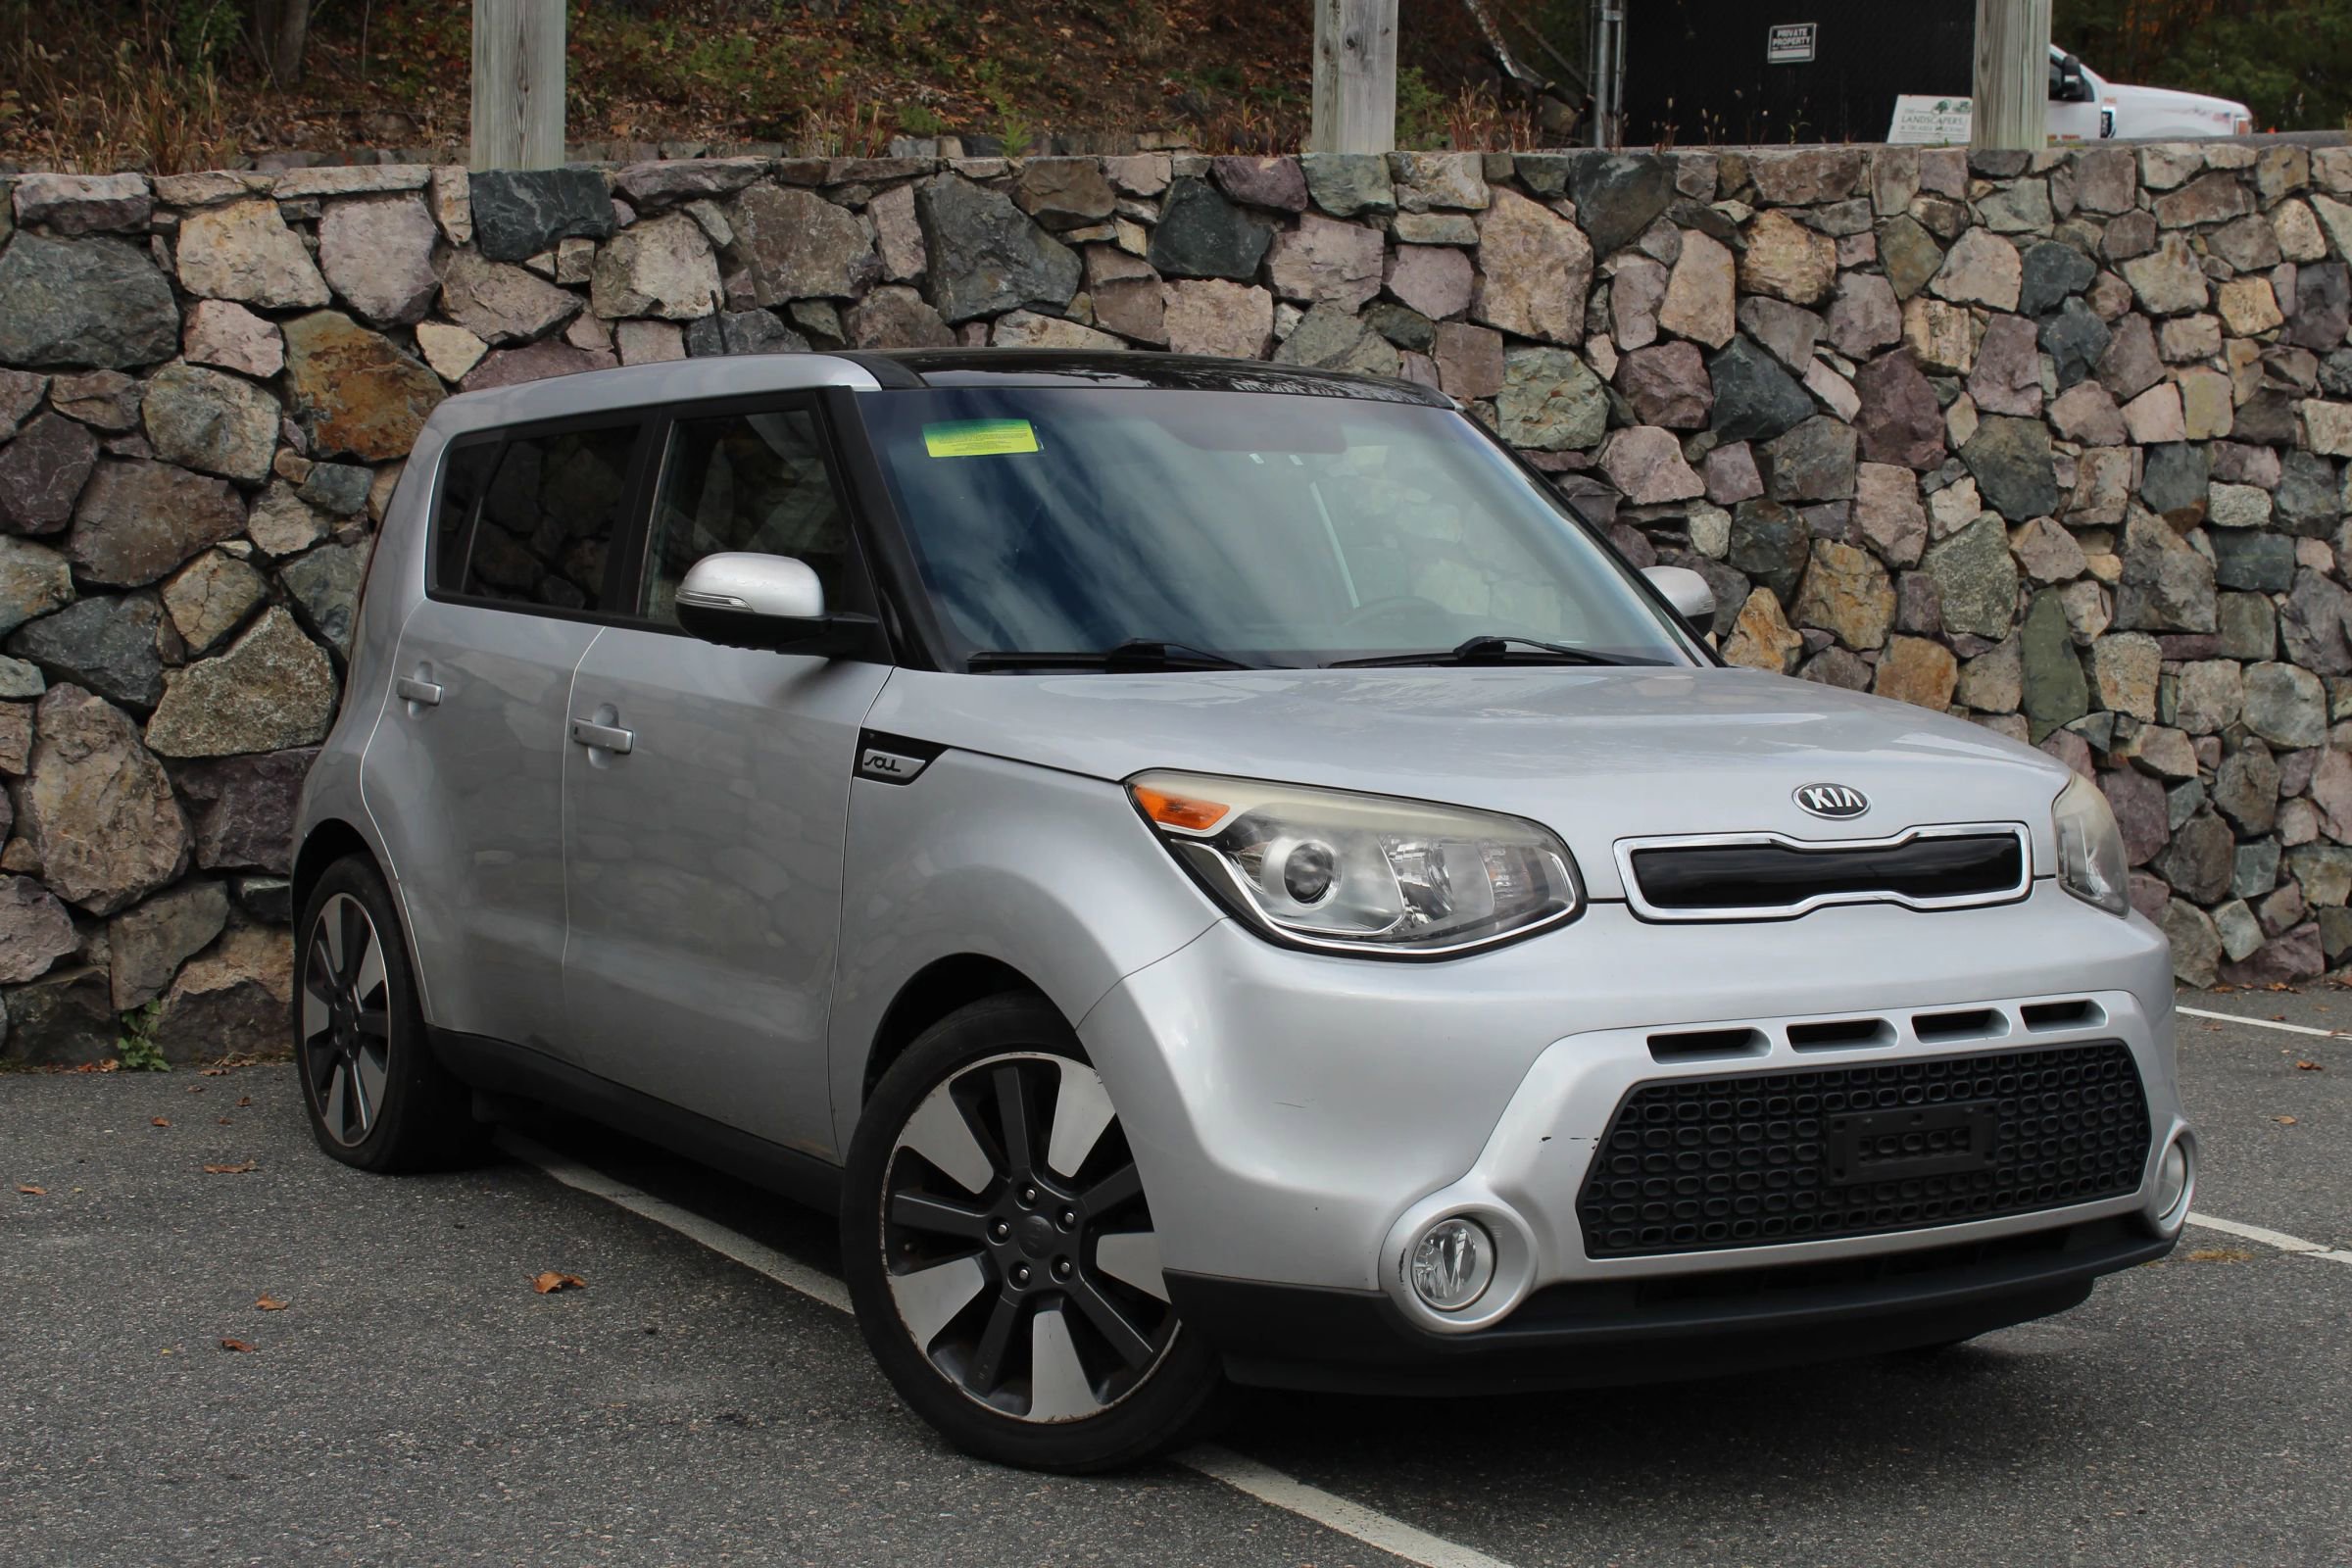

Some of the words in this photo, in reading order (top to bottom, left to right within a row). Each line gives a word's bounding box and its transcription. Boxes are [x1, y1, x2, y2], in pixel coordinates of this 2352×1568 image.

[1777, 28, 1808, 37] PRIVATE
[1772, 36, 1811, 46] PROPERTY
[1804, 787, 1864, 809] KIA
